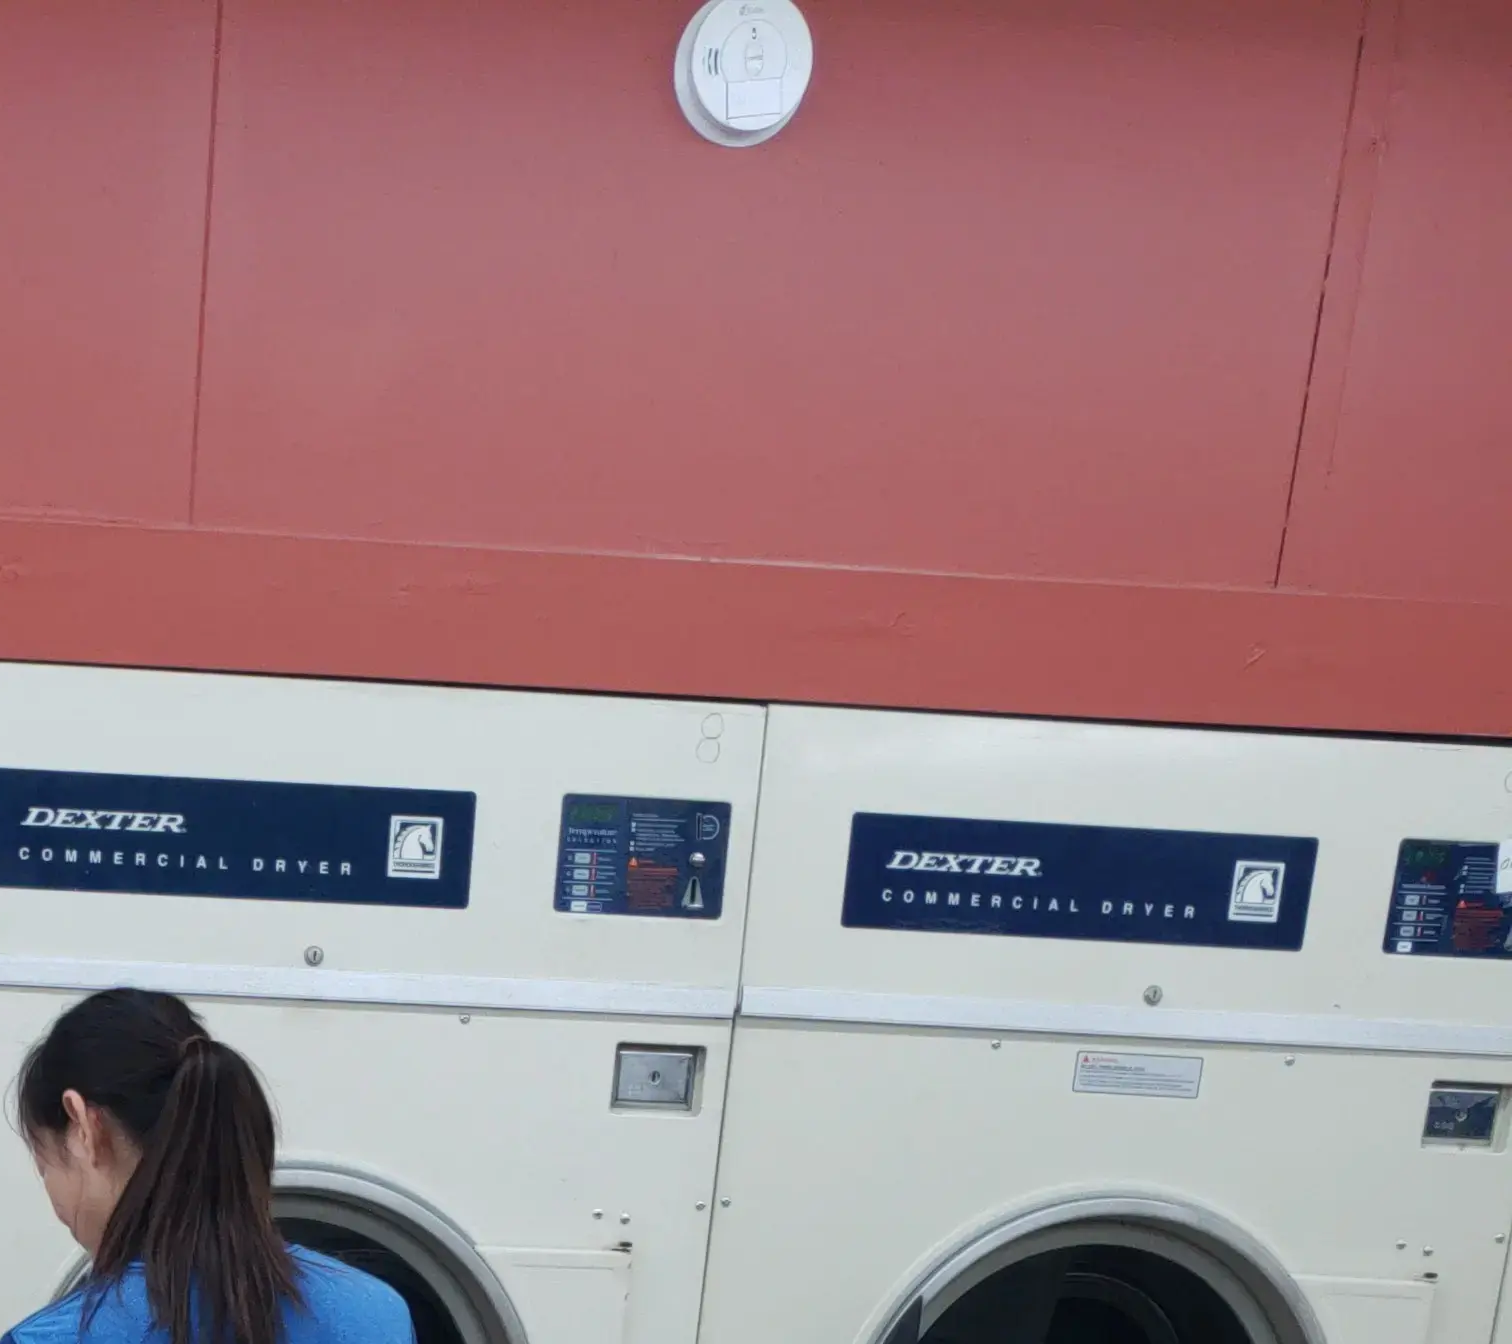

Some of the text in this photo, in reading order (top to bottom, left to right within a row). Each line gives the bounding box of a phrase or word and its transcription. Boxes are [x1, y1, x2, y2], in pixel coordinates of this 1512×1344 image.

[20, 807, 186, 833] DEXTER
[19, 847, 351, 875] COMMERCIAL DRYER
[885, 851, 1041, 876] DEXTER
[881, 889, 1195, 918] COMMERCIAL DRYER
